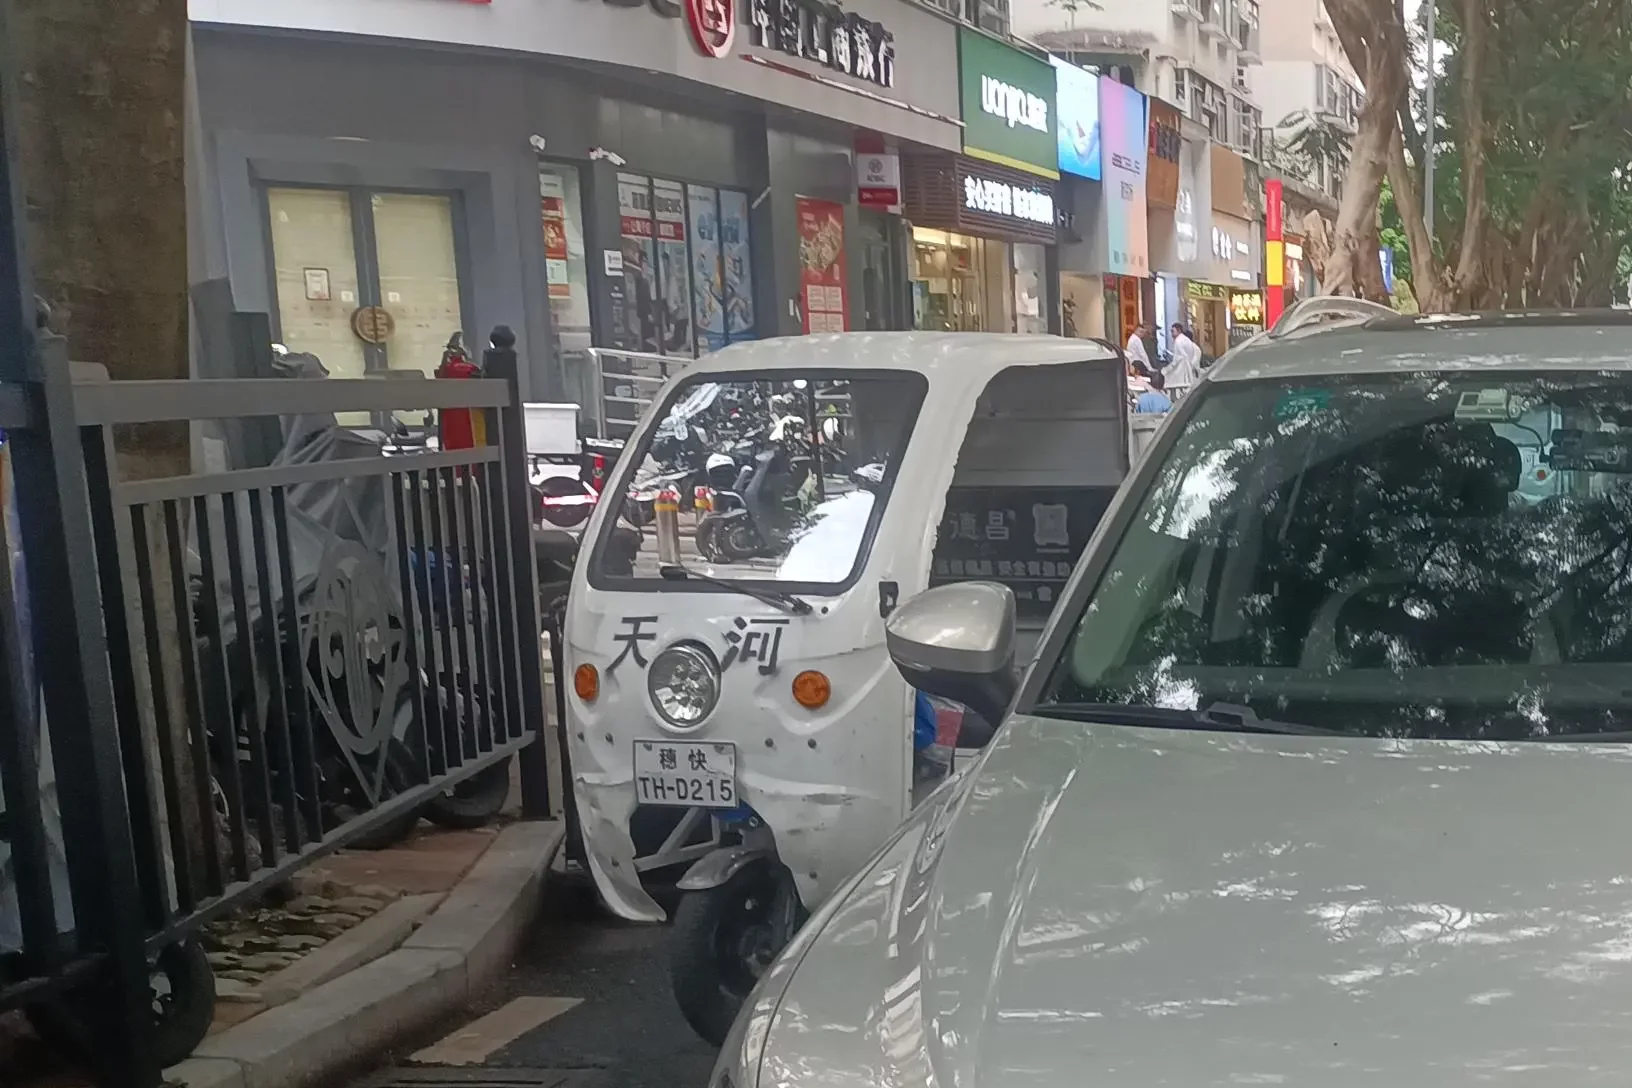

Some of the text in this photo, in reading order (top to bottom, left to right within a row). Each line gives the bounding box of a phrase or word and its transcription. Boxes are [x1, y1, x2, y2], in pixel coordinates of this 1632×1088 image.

[605, 616, 790, 676] 天河
[659, 749, 707, 770] 穗快
[638, 777, 732, 801] TH-D215
